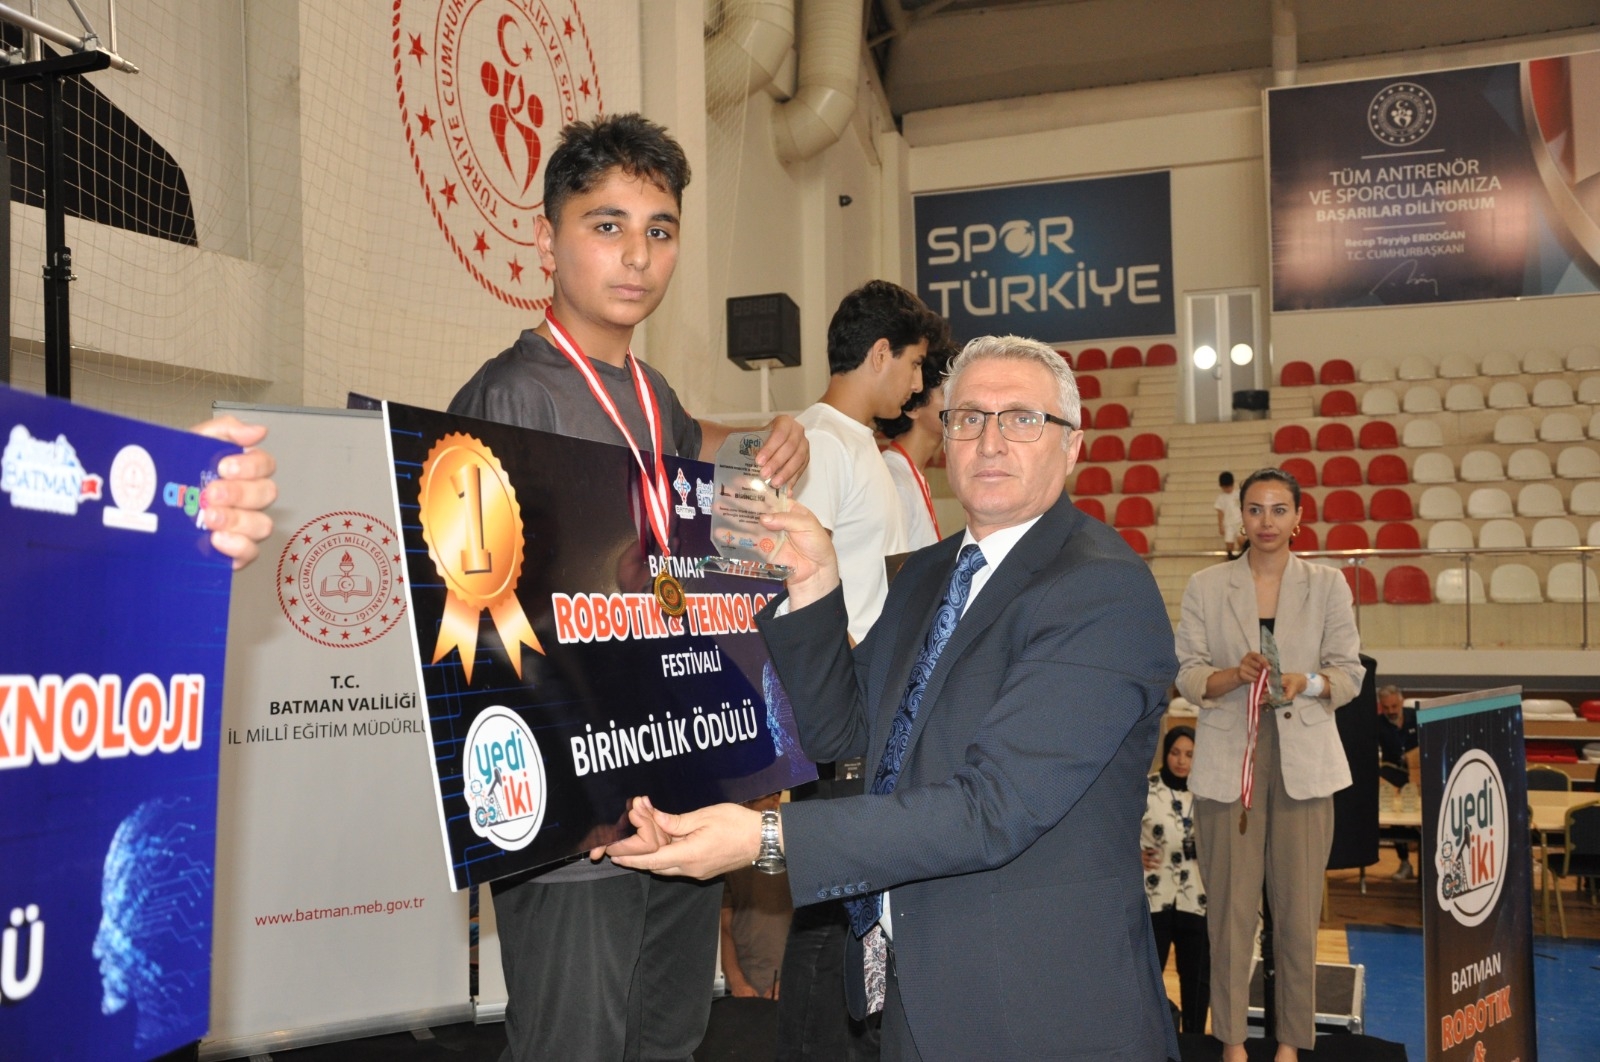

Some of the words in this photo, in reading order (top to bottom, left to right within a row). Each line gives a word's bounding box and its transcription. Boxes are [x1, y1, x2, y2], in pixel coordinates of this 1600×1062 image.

[522, 0, 548, 35] LİK
[441, 0, 466, 106] CUMHUR
[549, 35, 562, 68] VE
[559, 74, 574, 122] SPO
[448, 115, 498, 218] TÜRKİYE
[1329, 168, 1371, 186] TÜM
[1375, 157, 1480, 183] ANTRENÖR
[1309, 189, 1332, 205] VE
[1336, 176, 1502, 203] SPORCULARIMIZA
[1316, 204, 1402, 223] BAŞARILAR
[1405, 196, 1495, 216] DİLİYORUM
[927, 216, 1075, 265] SPOR
[1345, 238, 1376, 248] Recep
[1376, 235, 1411, 247] Tayyip
[1412, 229, 1466, 243] ERDOĞAN
[928, 261, 1161, 318] TÜRKİYE
[6, 461, 82, 496] BATMAN
[450, 463, 492, 575] 1
[303, 536, 341, 590] CUMHURİYETİ
[370, 547, 389, 577] EĞİTİM
[648, 555, 705, 578] BATMAN
[305, 593, 336, 622] TÜRKİYE
[356, 579, 389, 621] BAKANLIĞI
[668, 615, 685, 636] &
[684, 592, 778, 636] TEKNOL
[661, 645, 722, 678] FESTİVALİ
[330, 675, 360, 689] T.C.
[270, 699, 344, 715] BATMAN
[348, 692, 417, 711] VALİLİĞİ
[228, 728, 242, 745] İL
[246, 724, 289, 743] MİLLÎ
[293, 722, 348, 740] EĞİTİM
[570, 711, 692, 777] BİRİNCİLİK
[693, 699, 758, 751] ÖDÜLÜ
[475, 728, 526, 785] yedi
[502, 771, 533, 817] iki
[1450, 776, 1494, 847] yedi
[1470, 829, 1495, 886] iki
[255, 896, 425, 926] www.batman.meb.gov.tr
[1451, 952, 1502, 995] BATMAN
